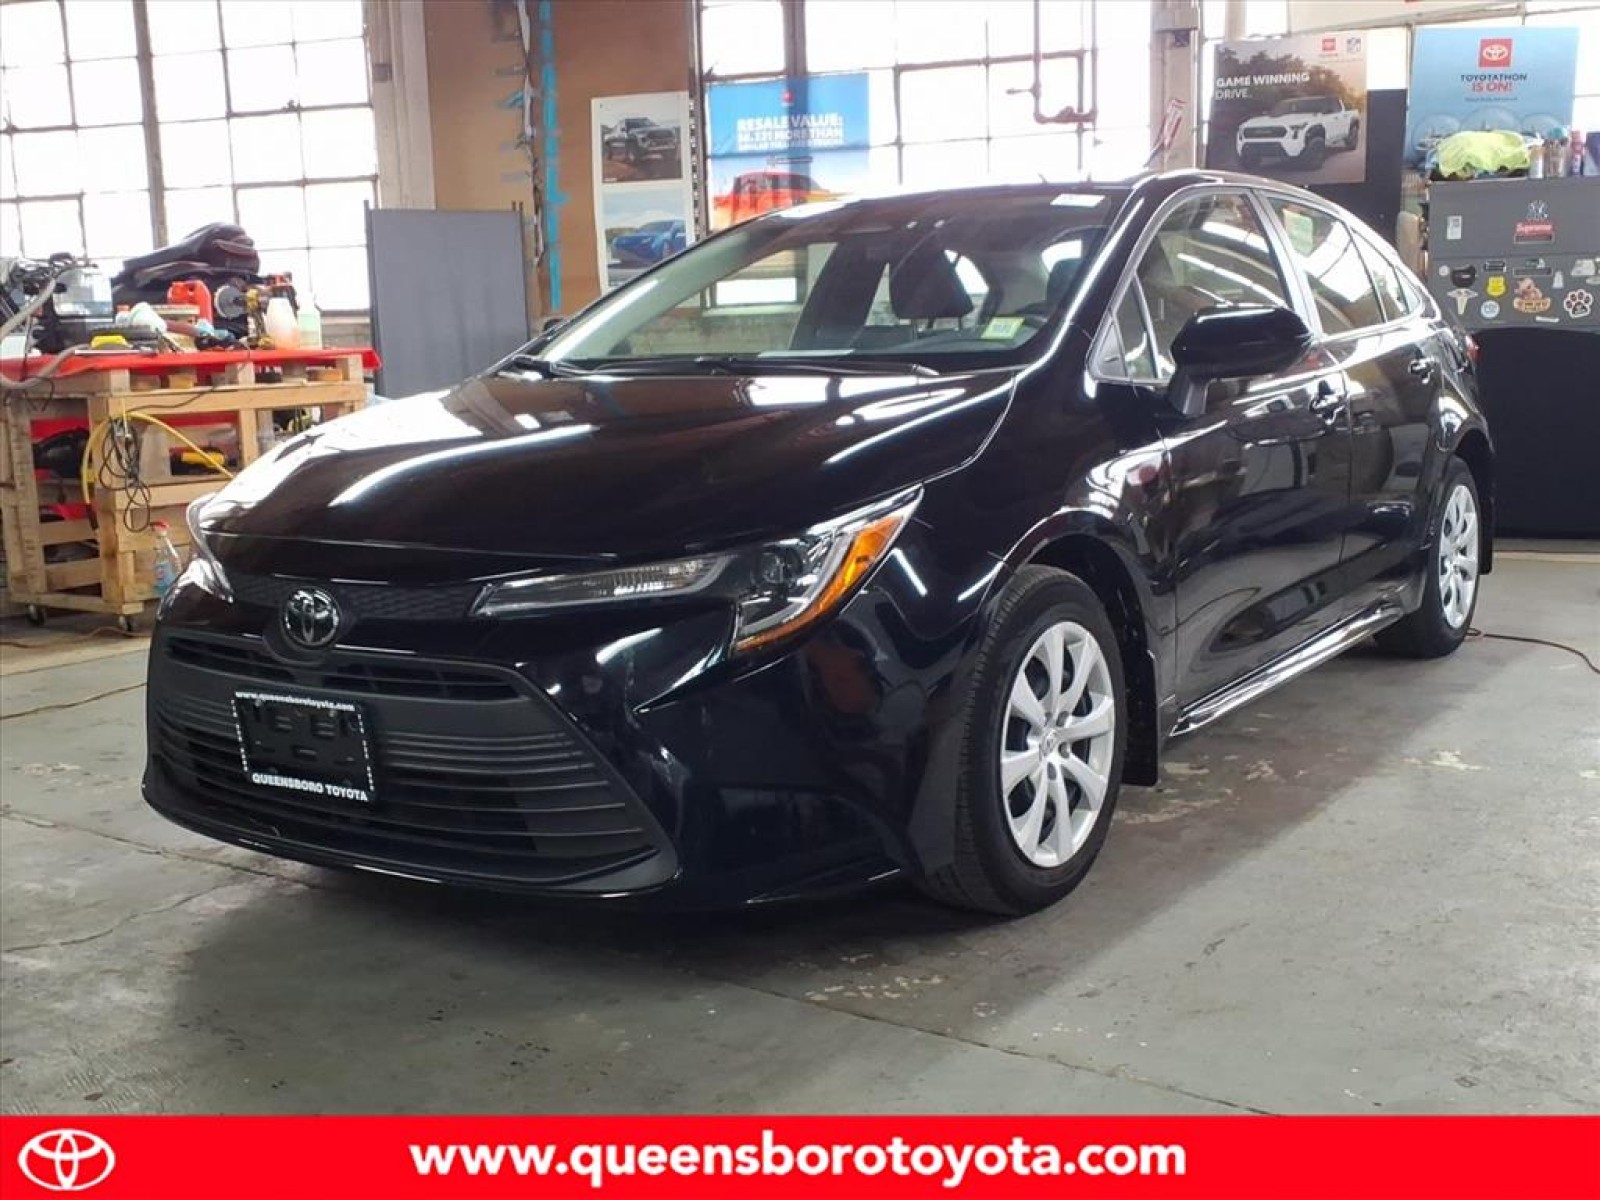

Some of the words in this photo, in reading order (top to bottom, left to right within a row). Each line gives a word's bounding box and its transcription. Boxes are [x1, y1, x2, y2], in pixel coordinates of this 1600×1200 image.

[1216, 76, 1250, 87] GAME
[1252, 72, 1310, 85] WINNING
[1461, 73, 1527, 81] TOYOTATHON
[1472, 82, 1483, 92] IS
[1486, 82, 1513, 92] ON!
[235, 691, 356, 712] www.queensborotoyota.com
[252, 773, 324, 794] QUEENSBORO
[325, 784, 369, 802] TOYOTA
